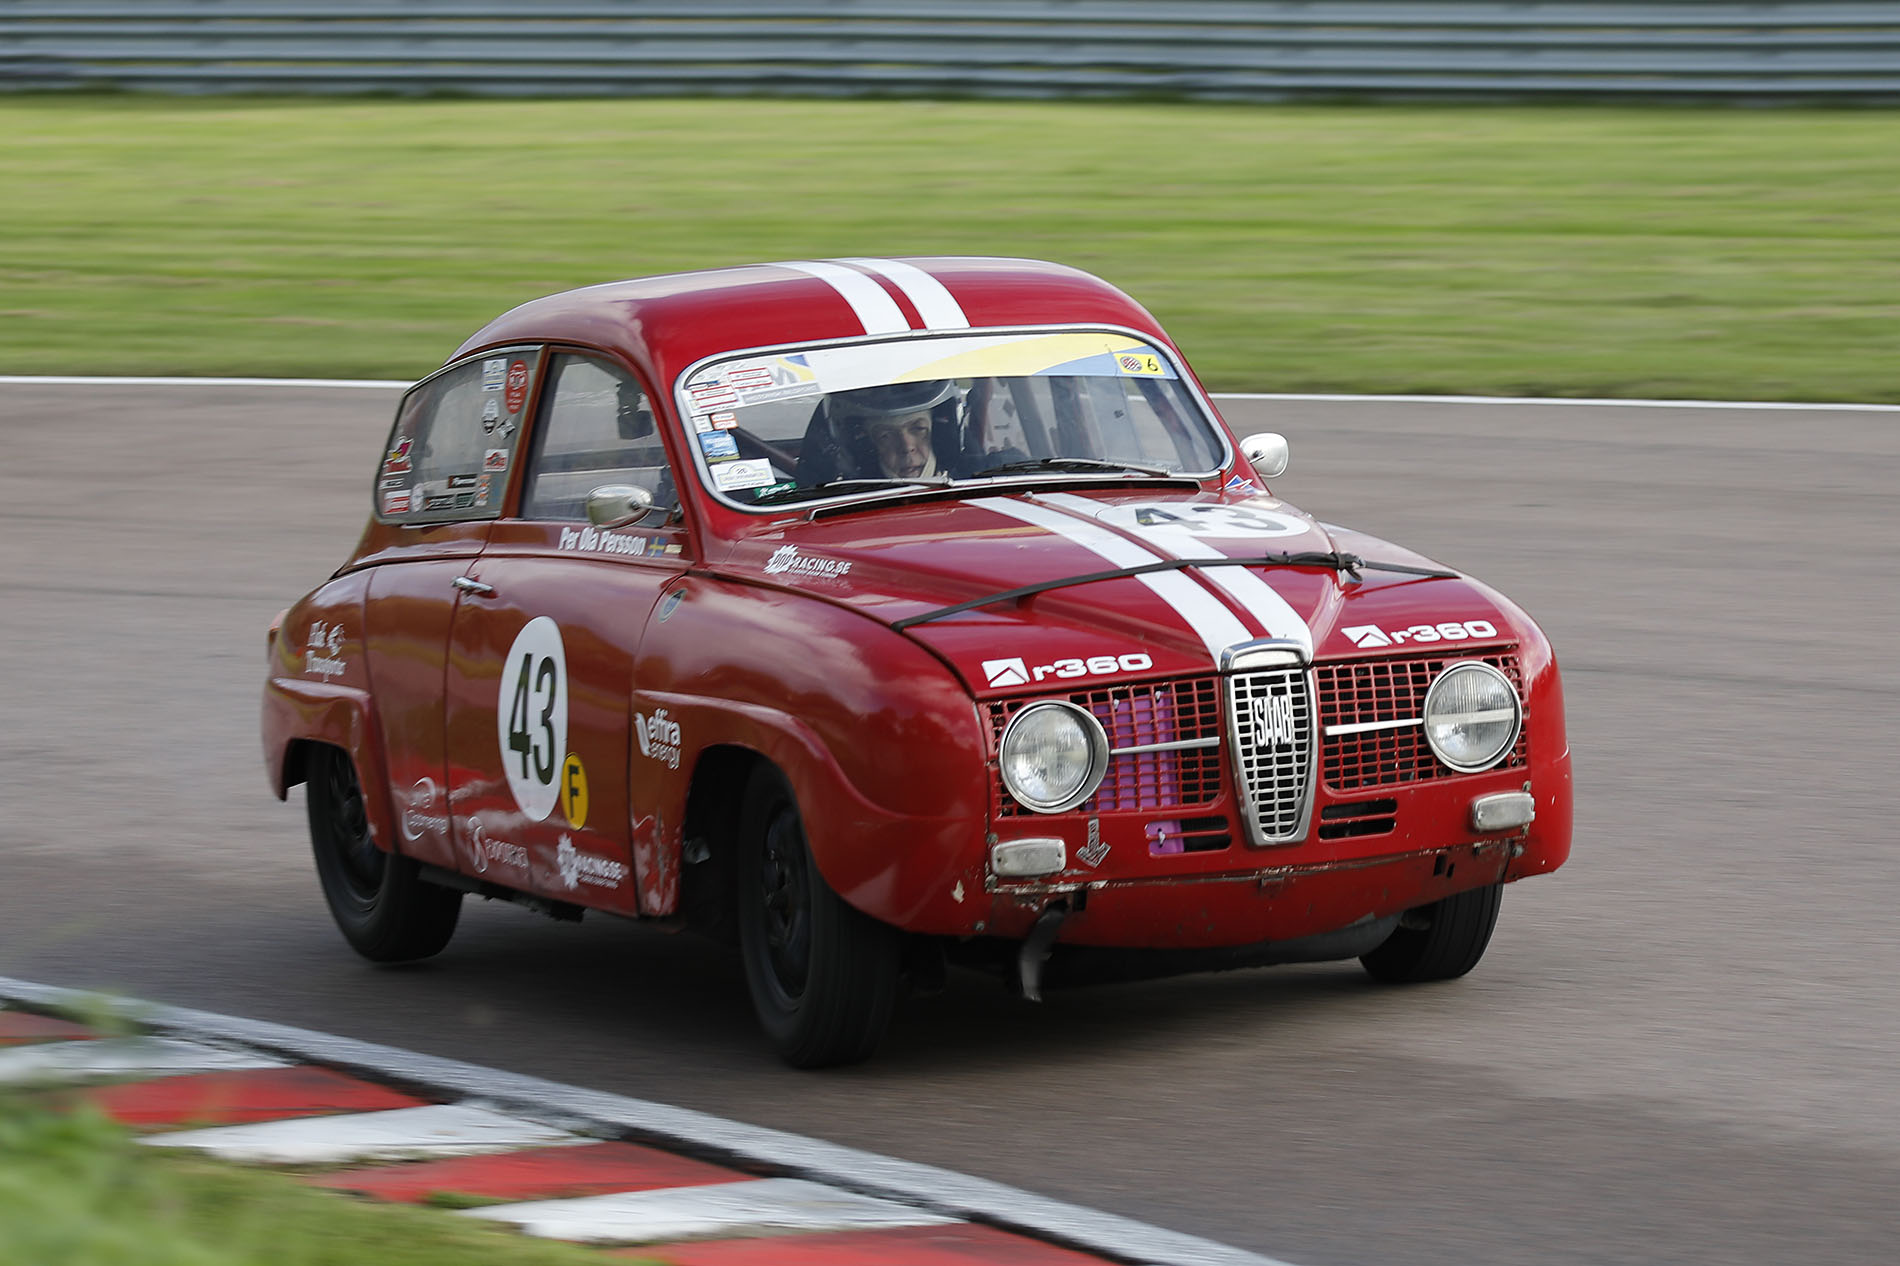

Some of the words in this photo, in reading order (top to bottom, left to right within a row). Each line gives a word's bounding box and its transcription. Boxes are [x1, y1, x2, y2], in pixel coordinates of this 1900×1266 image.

[1134, 505, 1288, 532] 43
[597, 530, 647, 556] Persson
[1390, 620, 1498, 645] r360
[1032, 653, 1153, 681] r360
[509, 652, 557, 785] 43
[1253, 695, 1292, 747] SAAB
[568, 763, 580, 819] F
